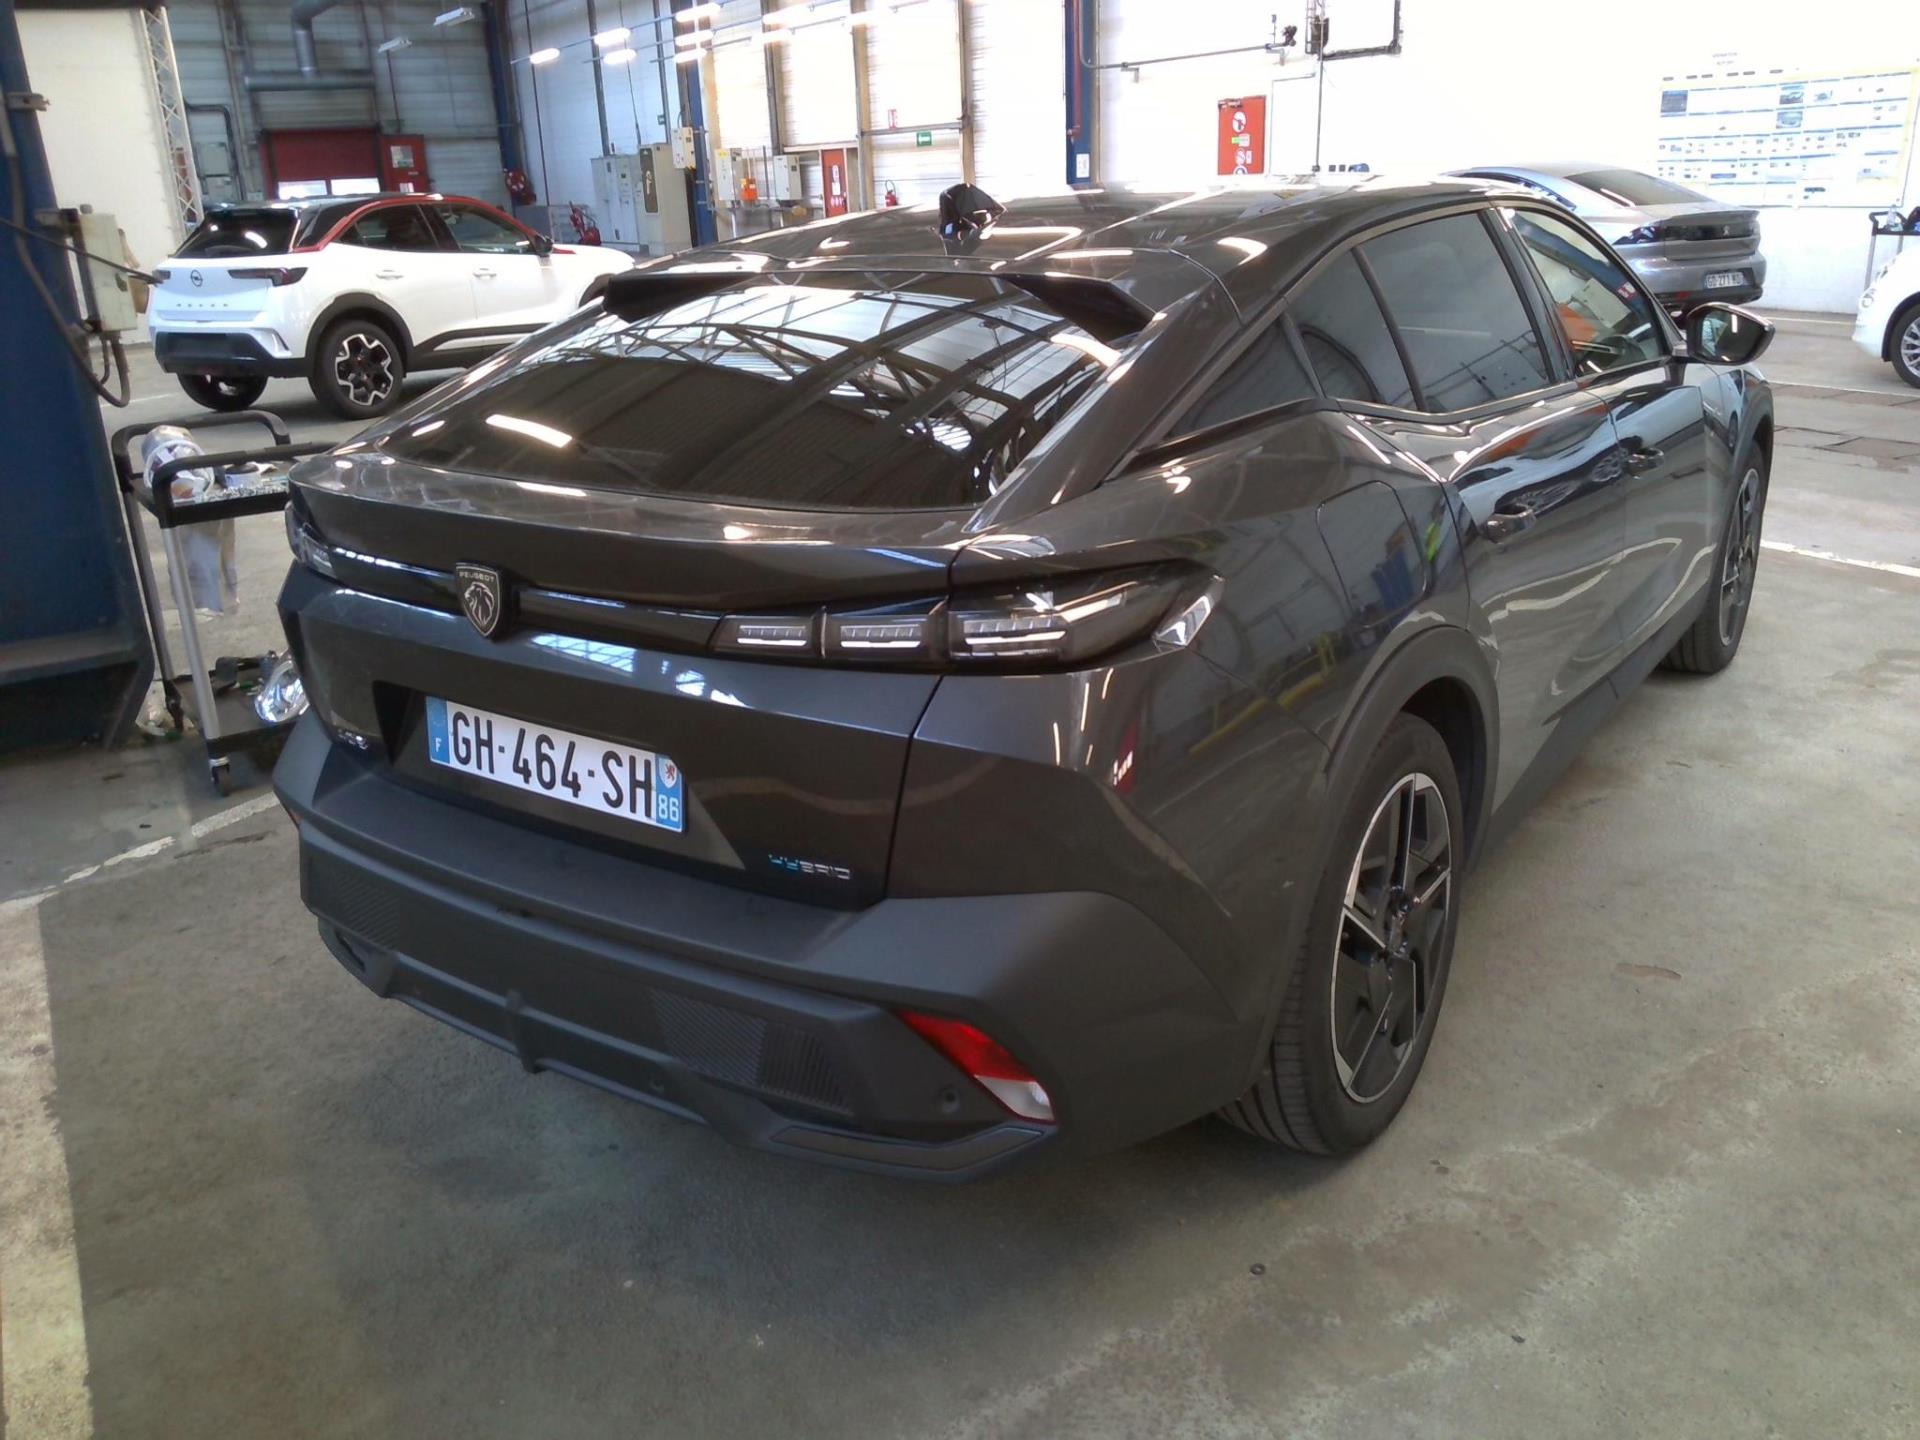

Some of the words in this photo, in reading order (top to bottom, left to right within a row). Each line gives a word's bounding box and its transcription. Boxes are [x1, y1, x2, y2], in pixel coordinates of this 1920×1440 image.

[434, 737, 442, 752] F
[452, 711, 651, 818] GH-464-SH
[657, 794, 680, 822] 86
